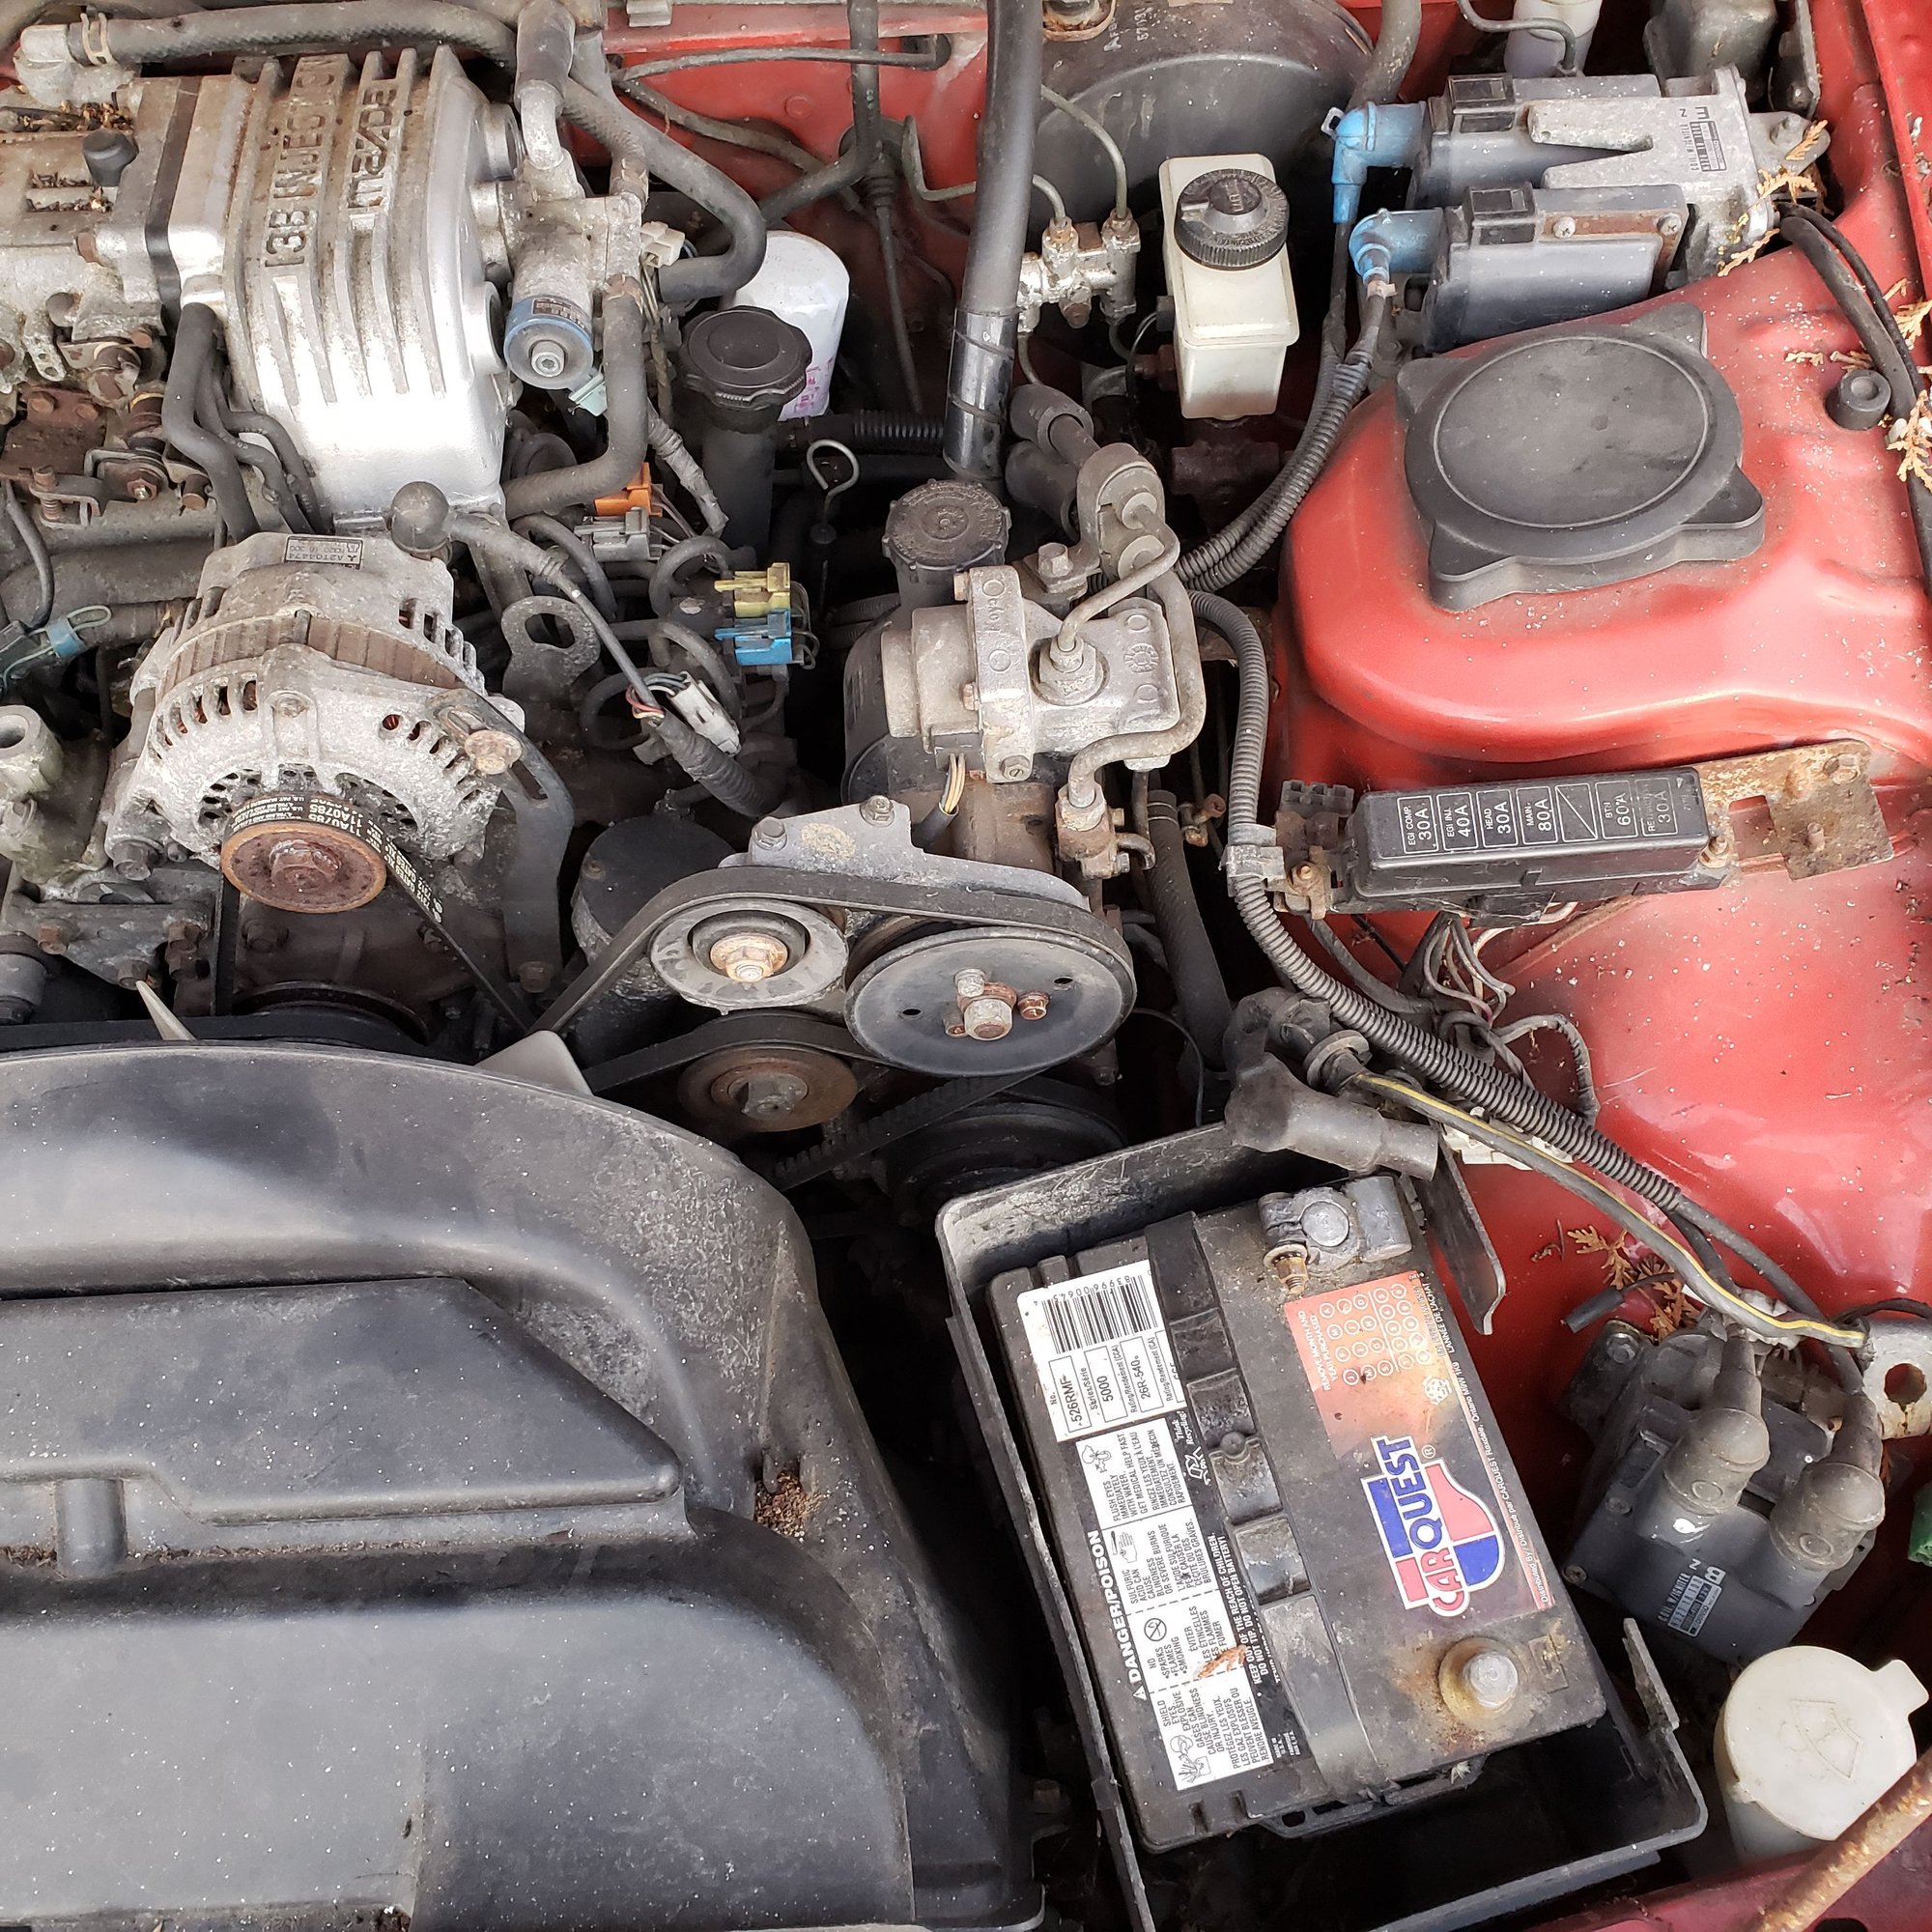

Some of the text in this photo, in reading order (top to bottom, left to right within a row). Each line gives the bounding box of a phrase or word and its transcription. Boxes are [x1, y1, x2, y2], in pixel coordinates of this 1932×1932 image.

[1483, 808, 1493, 829] HEAD
[1493, 801, 1511, 834] 30A
[1534, 798, 1551, 831] 80A
[1653, 790, 1670, 823] 30A
[1414, 808, 1432, 839] 30A
[1445, 823, 1454, 837] EGI
[1454, 804, 1471, 838] 40A
[1406, 832, 1416, 844] EGI
[1422, 1281, 1438, 1311] L'ACHAT
[1434, 1311, 1443, 1321] DE
[1297, 1309, 1331, 1390] REMOVE MONTH AND
[1325, 1359, 1338, 1380] YEAR
[1451, 1360, 1463, 1376] 1K9
[1047, 1391, 1058, 1405] No.
[1095, 1375, 1114, 1403] 5000
[1464, 1395, 1480, 1422] Ontario
[1129, 1431, 1141, 1449] L'EAU
[1122, 1450, 1134, 1468] HELP
[1137, 1455, 1149, 1473] YEUX
[1155, 1458, 1165, 1467] UN
[1127, 1468, 1144, 1499] MEDICAL
[1142, 1473, 1152, 1486] LES
[1159, 1468, 1177, 1505] CONSULTEZ
[1487, 1455, 1510, 1500] CARQUEST
[1102, 1480, 1121, 1520] FLUSH EYES
[1109, 1473, 1129, 1519] IMMEDIATELY
[1125, 1497, 1138, 1516] WITH
[1137, 1500, 1148, 1513] GET
[1147, 1487, 1160, 1510] RINCEZ
[1171, 1533, 1179, 1543] LA
[1377, 1438, 1464, 1612] CARQUEST
[1158, 1522, 1178, 1565] SULFURIQUE
[1174, 1543, 1188, 1570] CAUSER
[1181, 1537, 1192, 1550] DES
[1185, 1551, 1195, 1561] OU
[1216, 1535, 1236, 1574] BATTERY!
[1523, 1550, 1533, 1562] By
[1147, 1529, 1173, 1594] OR SEVERE BURNS
[1122, 1568, 1138, 1604] SULFURIC
[1130, 1568, 1147, 1602] ACID CAN
[1142, 1575, 1155, 1599] CAUSE
[1146, 1557, 1164, 1596] BLINDNESS
[1219, 1574, 1231, 1587] OF
[1229, 1573, 1243, 1596] OPEN
[1527, 1562, 1548, 1603] Distributed
[1087, 1528, 1142, 1683] DANGER/POISON
[1224, 1587, 1239, 1615] REACH
[1236, 1596, 1249, 1614] NOT
[1200, 1609, 1216, 1645] FLAMMES
[1212, 1620, 1227, 1646] FUMER
[1233, 1614, 1245, 1632] THE
[1241, 1613, 1253, 1627] DO
[1237, 1631, 1249, 1644] OF
[1147, 1657, 1156, 1668] NO
[1251, 1643, 1264, 1662] NOT
[1247, 1662, 1262, 1684] KEEP
[1257, 1662, 1268, 1675] DO
[1156, 1699, 1171, 1726] SHIELD
[1172, 1690, 1191, 1731] EXPLOSIVE
[1189, 1688, 1216, 1754] CAUSE BLINDNESS
[1186, 1706, 1205, 1747] GASES CAN
[1219, 1717, 1230, 1731] LES
[1223, 1697, 1250, 1766] LES GAZ EXPLOSIFS
[1230, 1687, 1260, 1763] PEUVENT BLESSER OU
[1214, 1740, 1224, 1752] OR
[1253, 1731, 1268, 1760] RENDRE
